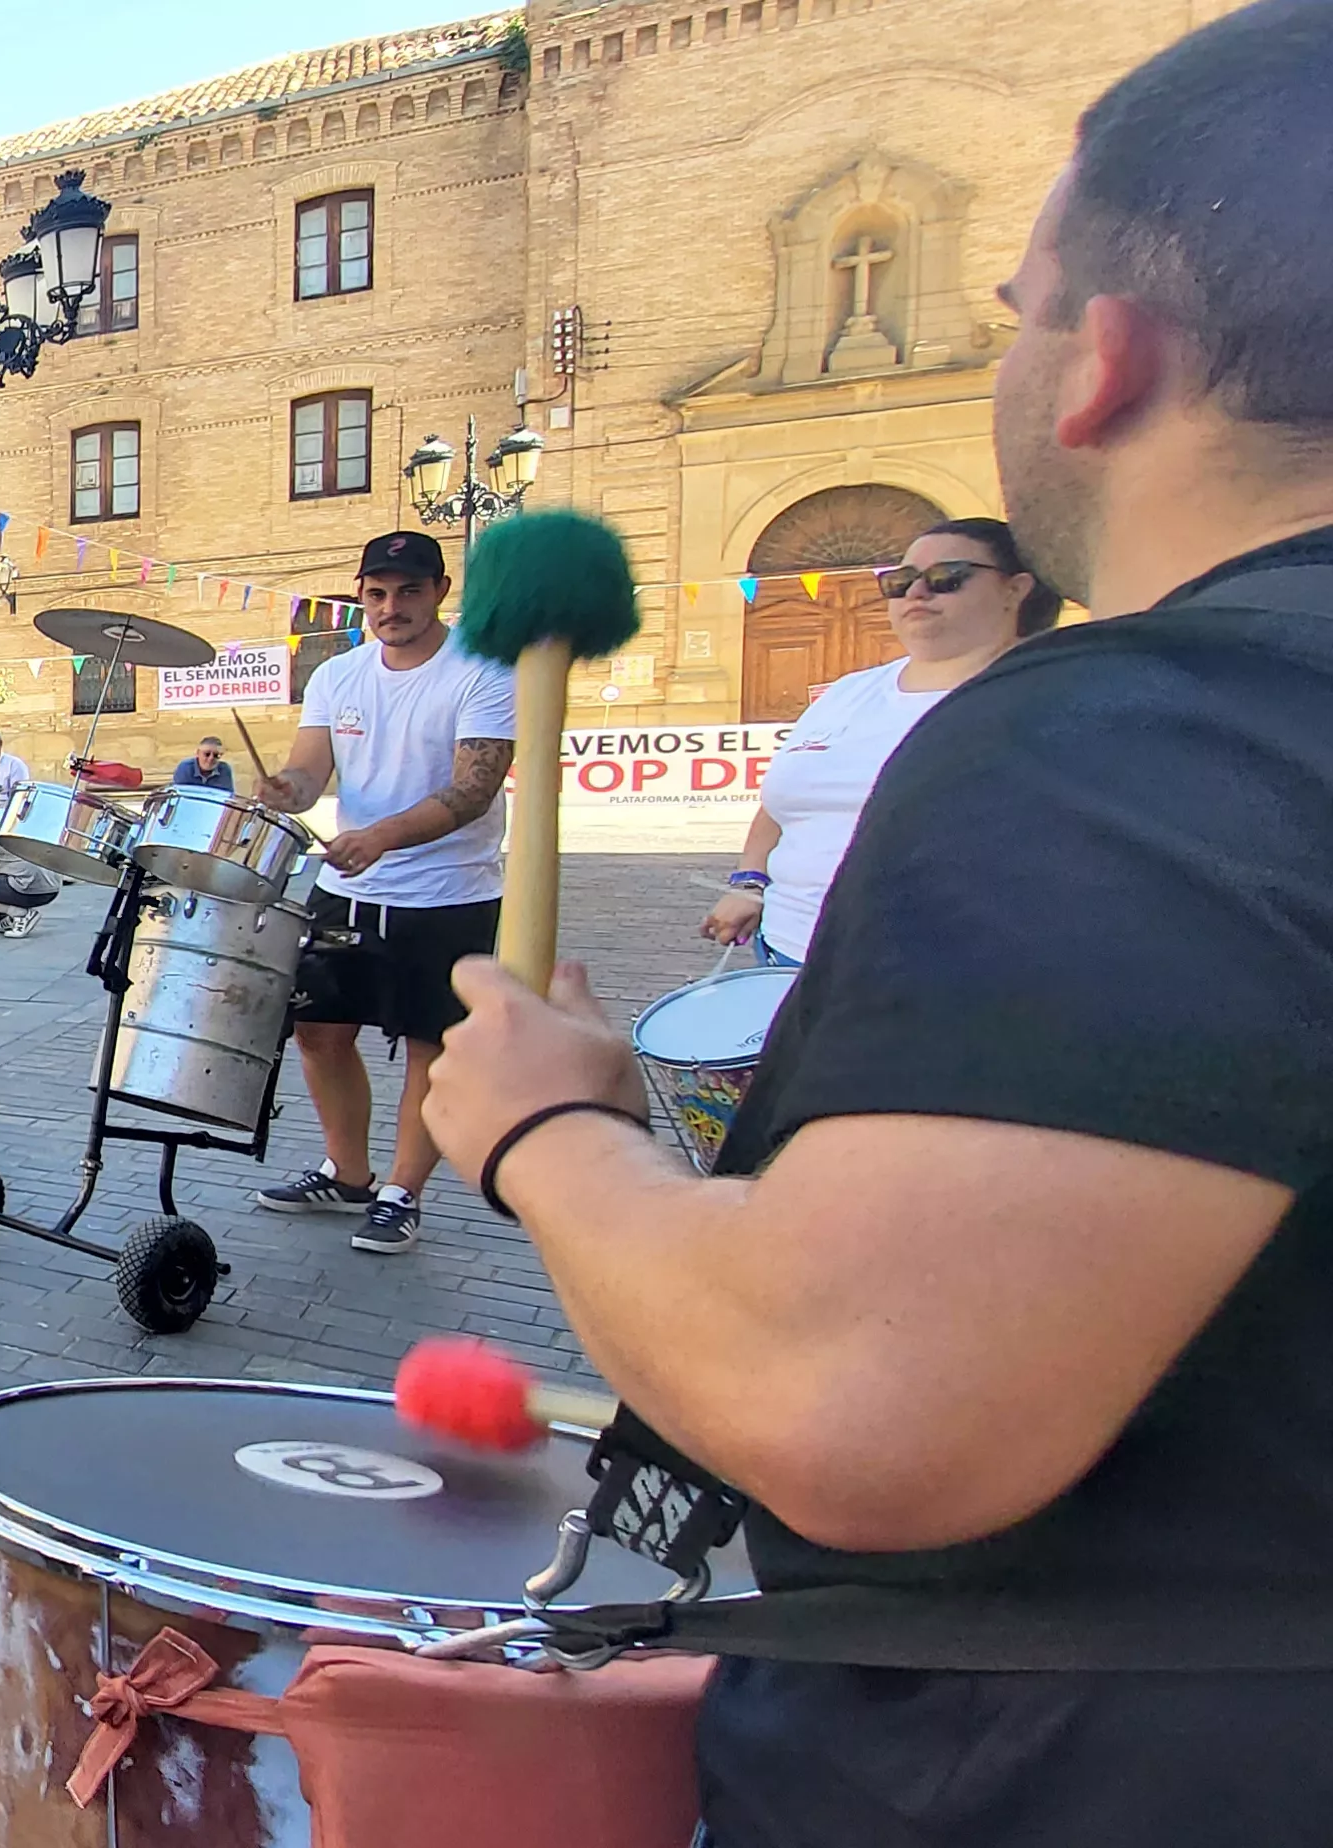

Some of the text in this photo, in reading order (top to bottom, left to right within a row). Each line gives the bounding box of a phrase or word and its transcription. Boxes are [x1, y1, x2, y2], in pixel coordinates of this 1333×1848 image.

[164, 664, 281, 682] EL SEMINARIO
[165, 680, 281, 698] STOP DERRIBO
[560, 733, 704, 756] VEMOS
[718, 731, 761, 751] EL
[505, 760, 668, 793] TOP
[609, 796, 680, 804] PLATAFORMA
[731, 794, 762, 802] DEFE
